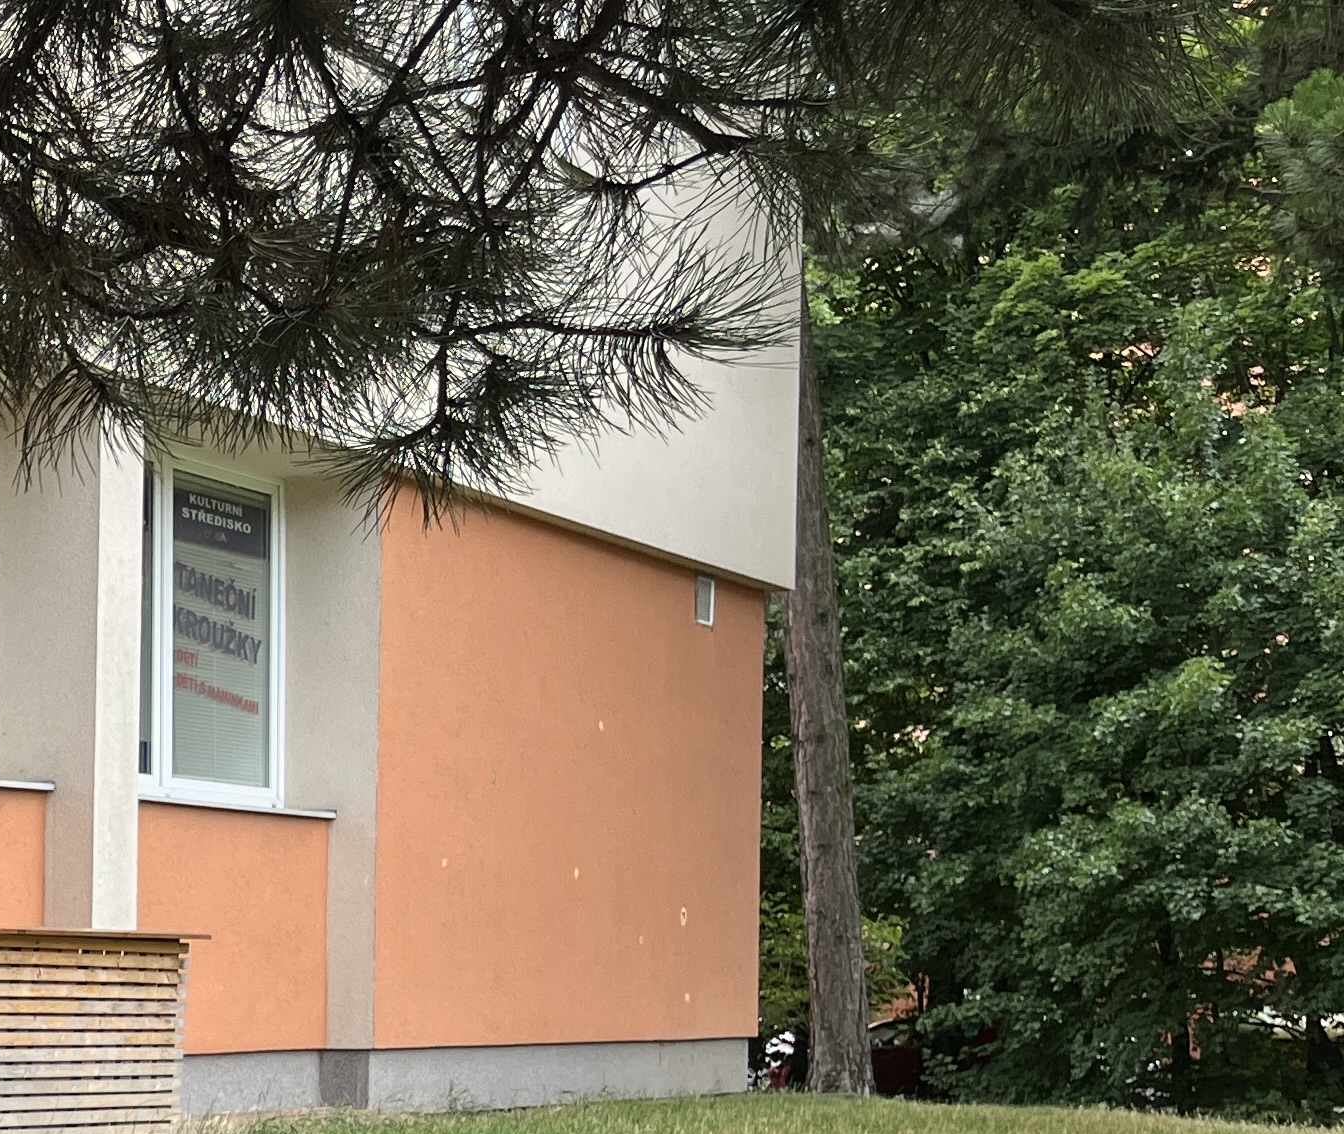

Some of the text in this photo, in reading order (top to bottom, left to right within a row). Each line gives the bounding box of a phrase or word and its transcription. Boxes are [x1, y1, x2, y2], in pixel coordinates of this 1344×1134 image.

[181, 506, 252, 534] STŘEDISKO
[189, 493, 243, 518] KULTURNÍ
[174, 561, 257, 621] TANEČNÍ
[173, 604, 262, 665] KROUŽKY
